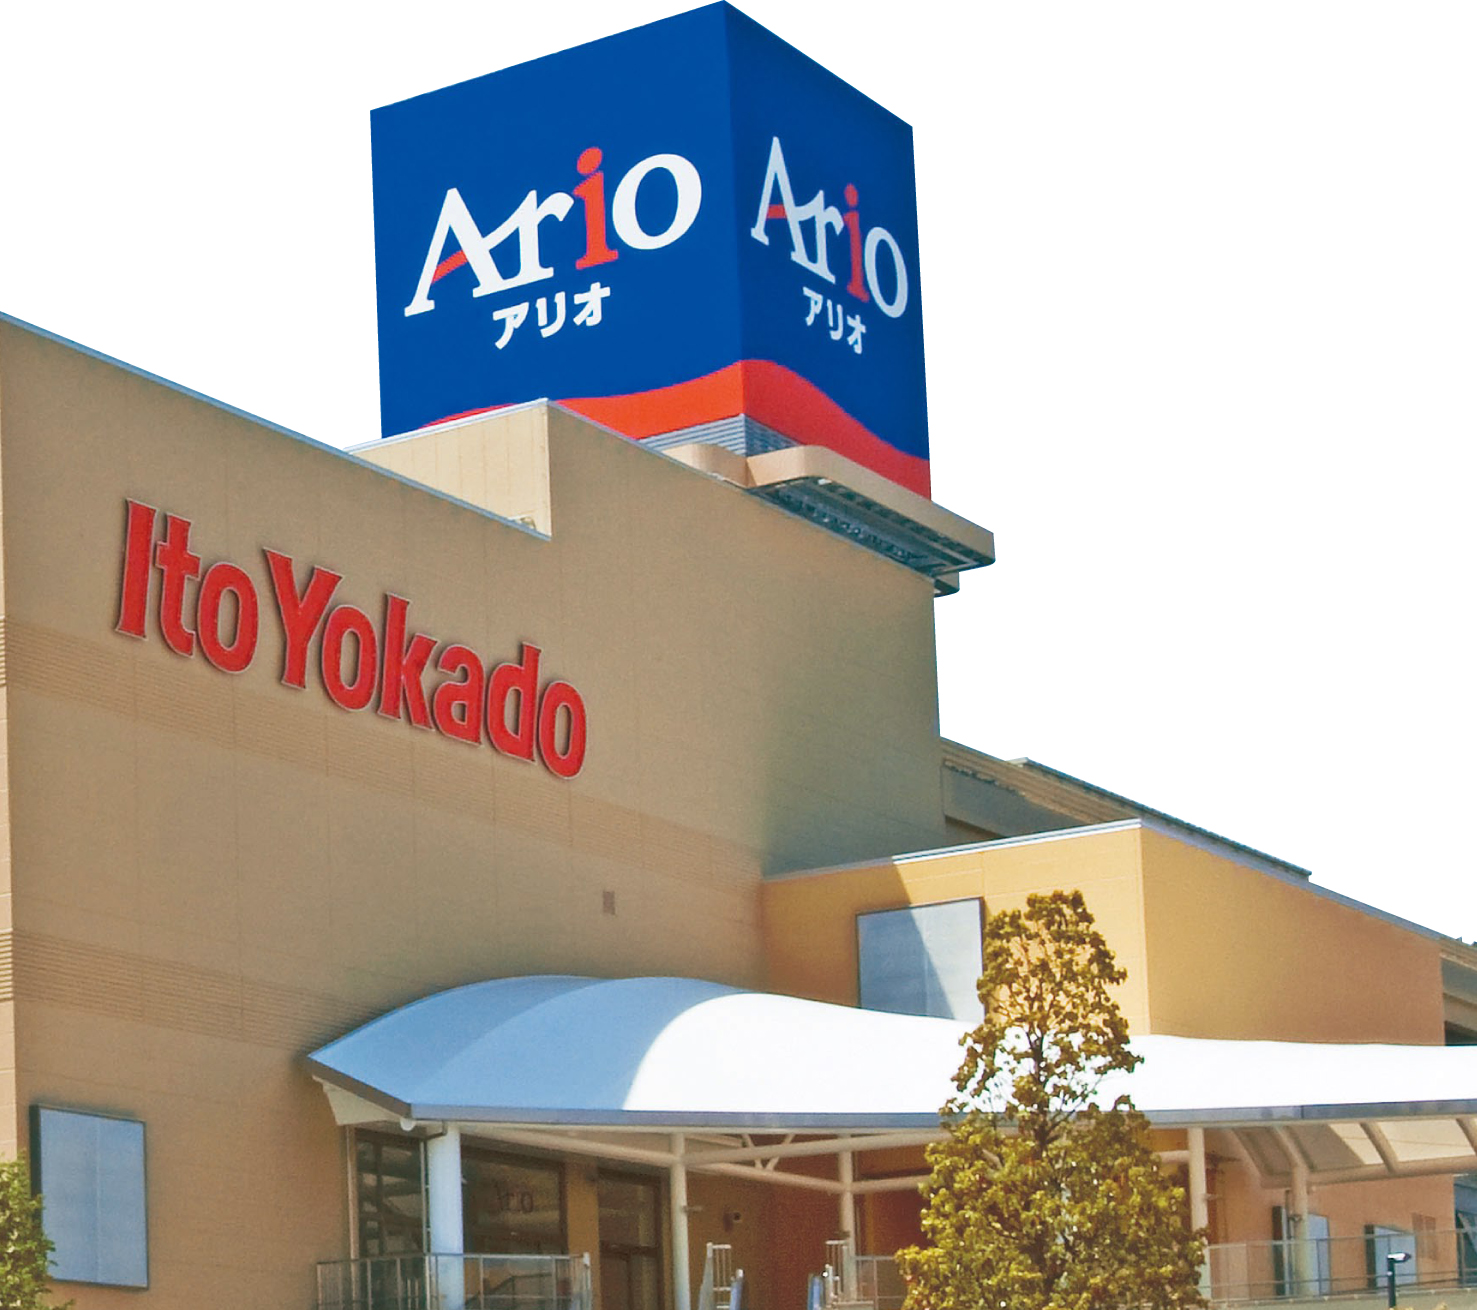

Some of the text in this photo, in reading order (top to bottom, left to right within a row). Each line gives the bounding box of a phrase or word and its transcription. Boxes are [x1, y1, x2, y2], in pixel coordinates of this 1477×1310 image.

[403, 146, 703, 318] Ario
[751, 135, 909, 319] Ario
[492, 282, 611, 350] アリオ
[802, 286, 867, 355] アリオ
